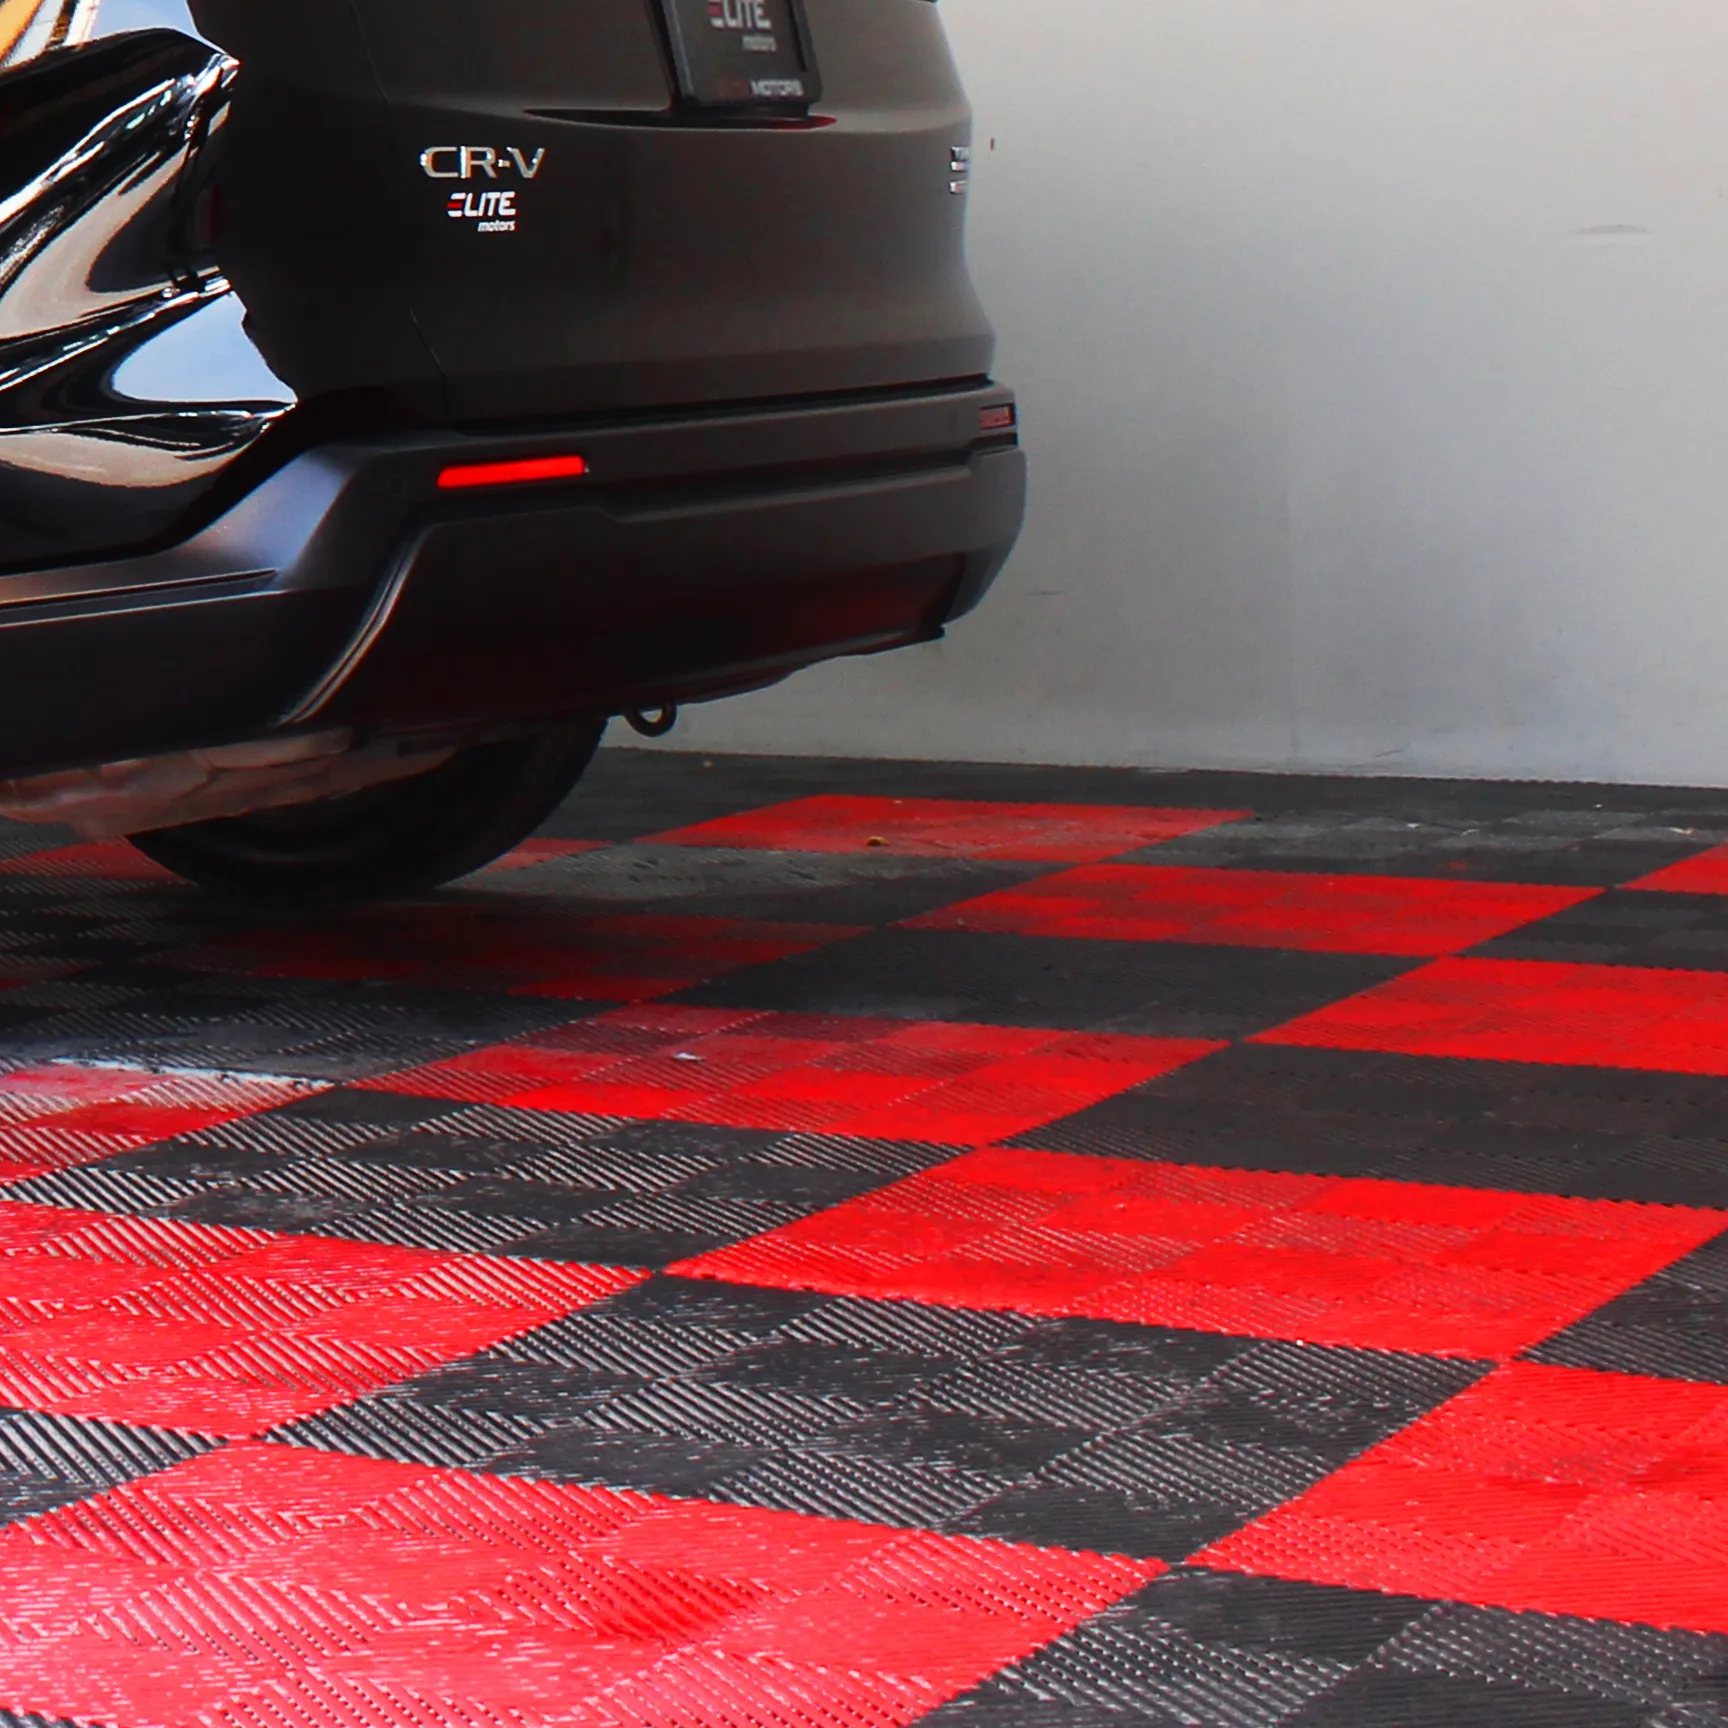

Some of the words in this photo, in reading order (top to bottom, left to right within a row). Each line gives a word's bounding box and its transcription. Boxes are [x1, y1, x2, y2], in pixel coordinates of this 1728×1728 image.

[420, 146, 545, 179] CR-V
[447, 191, 516, 217] ELITE
[477, 220, 516, 232] motors
